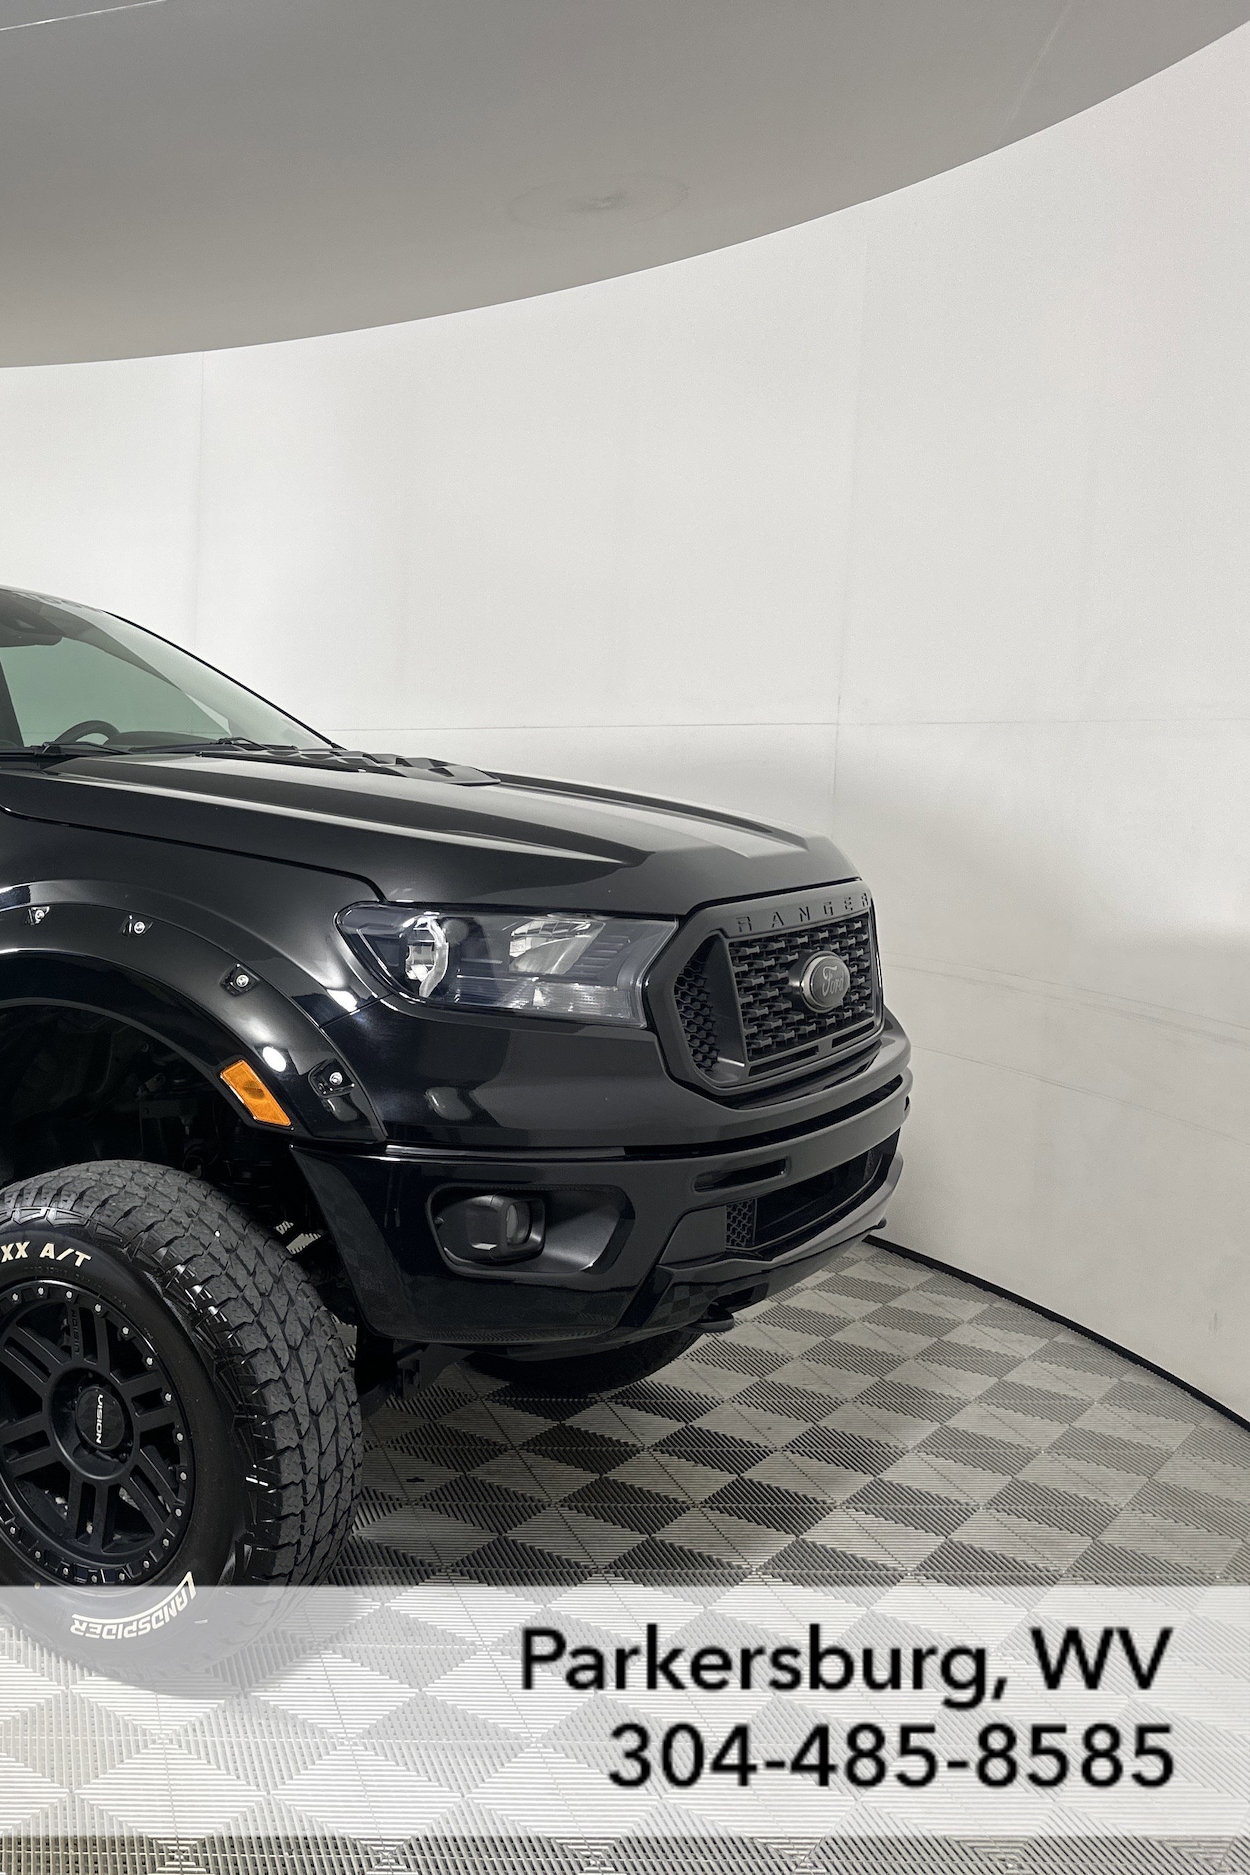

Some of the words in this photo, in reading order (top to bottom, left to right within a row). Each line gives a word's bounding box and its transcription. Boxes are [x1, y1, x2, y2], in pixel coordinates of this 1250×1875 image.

[735, 892, 870, 934] RANGER
[822, 964, 845, 997] Ford
[39, 1242, 92, 1268] A/T
[95, 1394, 104, 1445] VISION
[70, 1570, 197, 1640] LANDSPIDER
